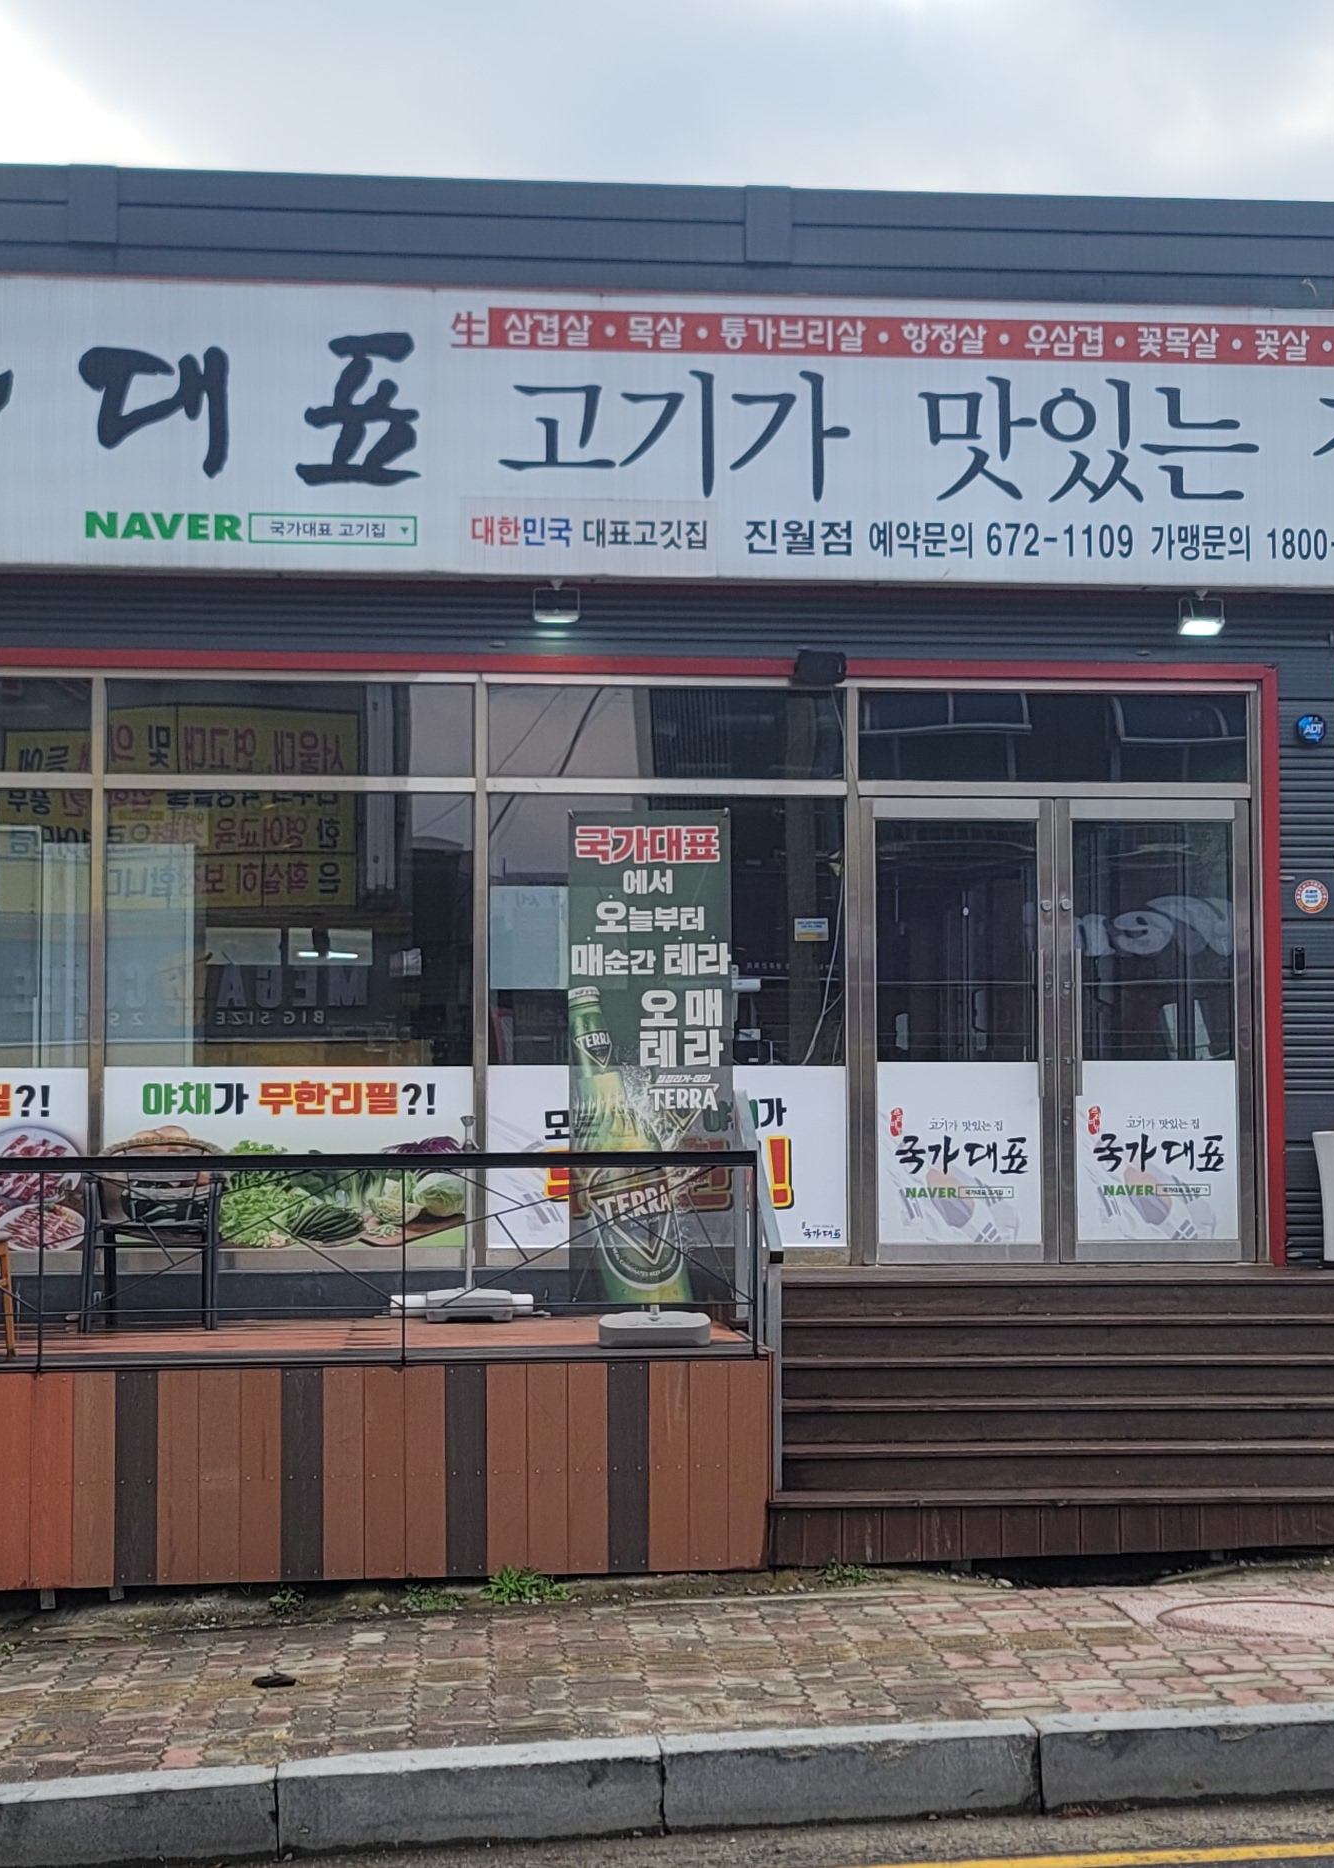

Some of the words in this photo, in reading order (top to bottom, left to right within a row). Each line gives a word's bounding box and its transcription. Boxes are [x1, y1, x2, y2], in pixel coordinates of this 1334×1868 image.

[504, 313, 593, 348] 삼겹살
[628, 316, 684, 350] 목살
[720, 318, 866, 353] 통가브리살
[901, 322, 986, 356] 항정살
[1024, 325, 1104, 358] 우삼겹
[1137, 326, 1219, 360] 꽃목살
[1255, 328, 1309, 362] 꽃살
[499, 370, 849, 502] 고기가
[918, 377, 1259, 503] 맛있는
[85, 510, 244, 541] NAVER
[270, 521, 333, 538] 국가대표
[338, 522, 386, 539] 고기집
[471, 516, 573, 548] 대한민국
[583, 518, 708, 550] 대표고깃집
[745, 519, 853, 556] 진월점
[869, 520, 973, 560] 예약문의
[986, 522, 1133, 558] 672-1109
[1151, 524, 1251, 562] 가맹문의
[1303, 723, 1323, 735] ADT
[576, 826, 720, 864] 국가대표
[623, 869, 673, 894] 에서
[595, 900, 705, 933] 오늘부터
[571, 943, 656, 976] 매순간
[664, 942, 731, 975] 테라
[639, 1029, 724, 1067] 테라
[142, 1081, 250, 1115] 야채가
[259, 1080, 436, 1116] 무한리필?!
[649, 1088, 718, 1111] TERRA
[929, 1118, 958, 1132] 고기가
[962, 1119, 992, 1132] 맛있는
[994, 1120, 1003, 1132] 집
[1126, 1116, 1155, 1129] 고기가
[1159, 1118, 1188, 1129] 맛있는
[1191, 1118, 1200, 1130] 집
[895, 1135, 1028, 1175] 국가대표
[1093, 1133, 1225, 1172] 국가대표
[597, 1184, 672, 1226] TERRA
[905, 1186, 957, 1199] NAVER
[1103, 1184, 1154, 1196] NAVER
